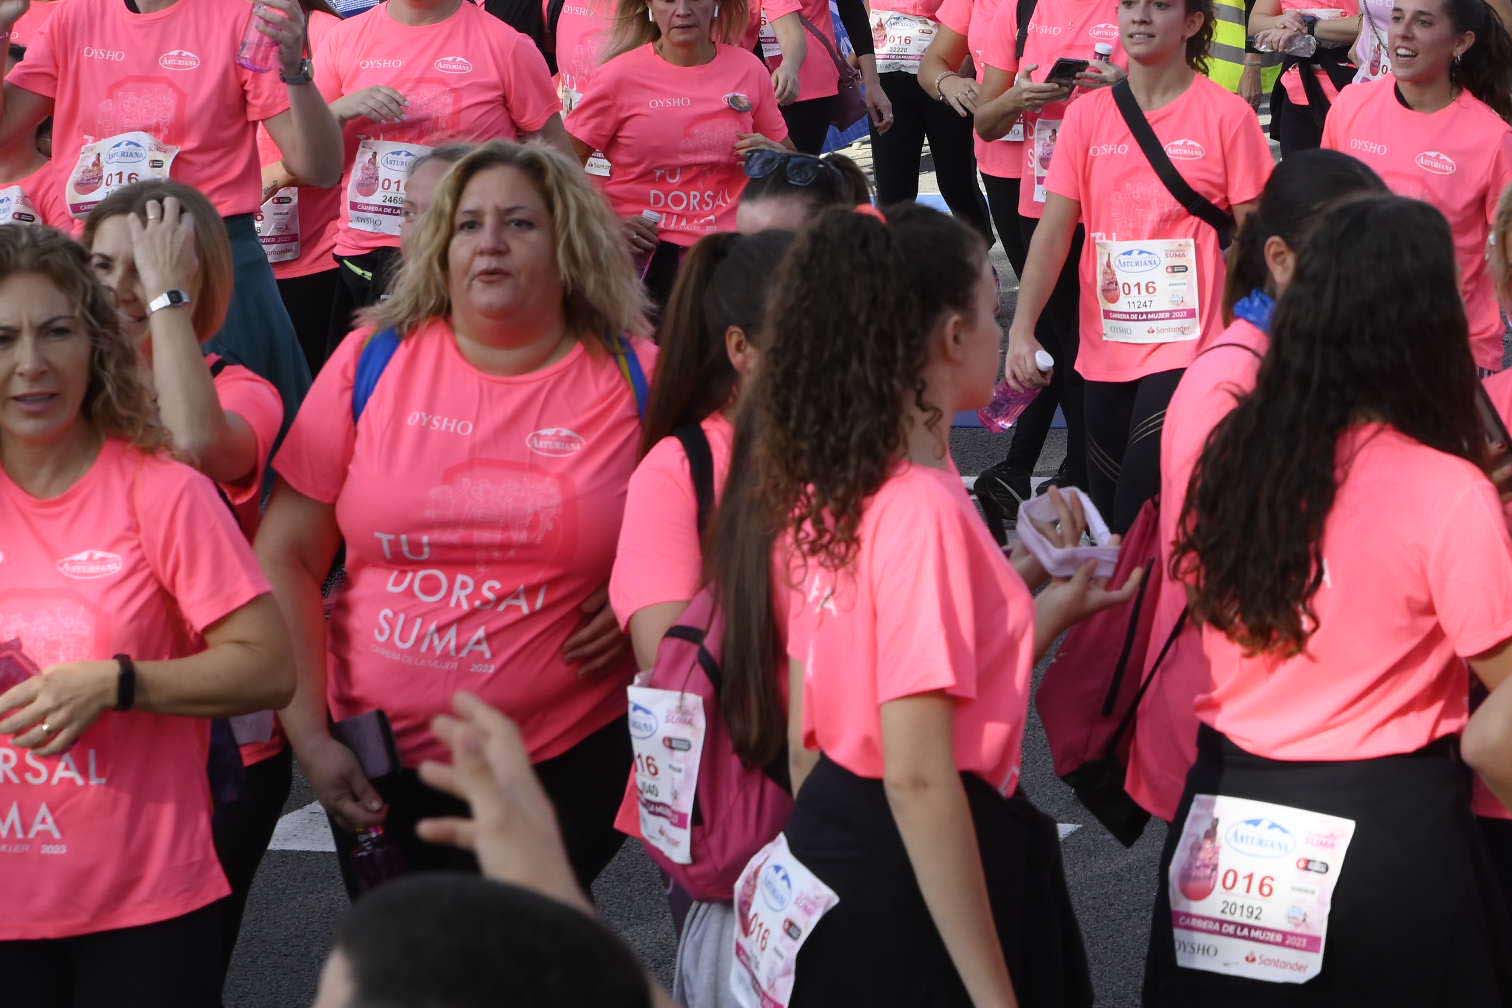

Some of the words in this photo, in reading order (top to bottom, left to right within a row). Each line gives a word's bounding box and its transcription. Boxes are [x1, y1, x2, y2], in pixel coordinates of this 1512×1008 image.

[888, 35, 912, 45] 016
[83, 46, 126, 62] OYSHO
[360, 58, 403, 70] OYSHO
[649, 96, 692, 109] OYSHO
[1351, 139, 1388, 155] OYSHO
[105, 171, 140, 187] 016
[381, 178, 401, 192] 01
[1122, 281, 1157, 296] 016
[1127, 300, 1153, 310] 11247
[407, 412, 474, 437] OYSHO
[373, 531, 430, 562] TU
[373, 608, 493, 659] SUMA
[1221, 868, 1275, 898] 016
[1219, 900, 1264, 922] 20192
[1222, 924, 1235, 935] DE
[1236, 927, 1250, 938] LA
[1258, 954, 1308, 973] Santander
